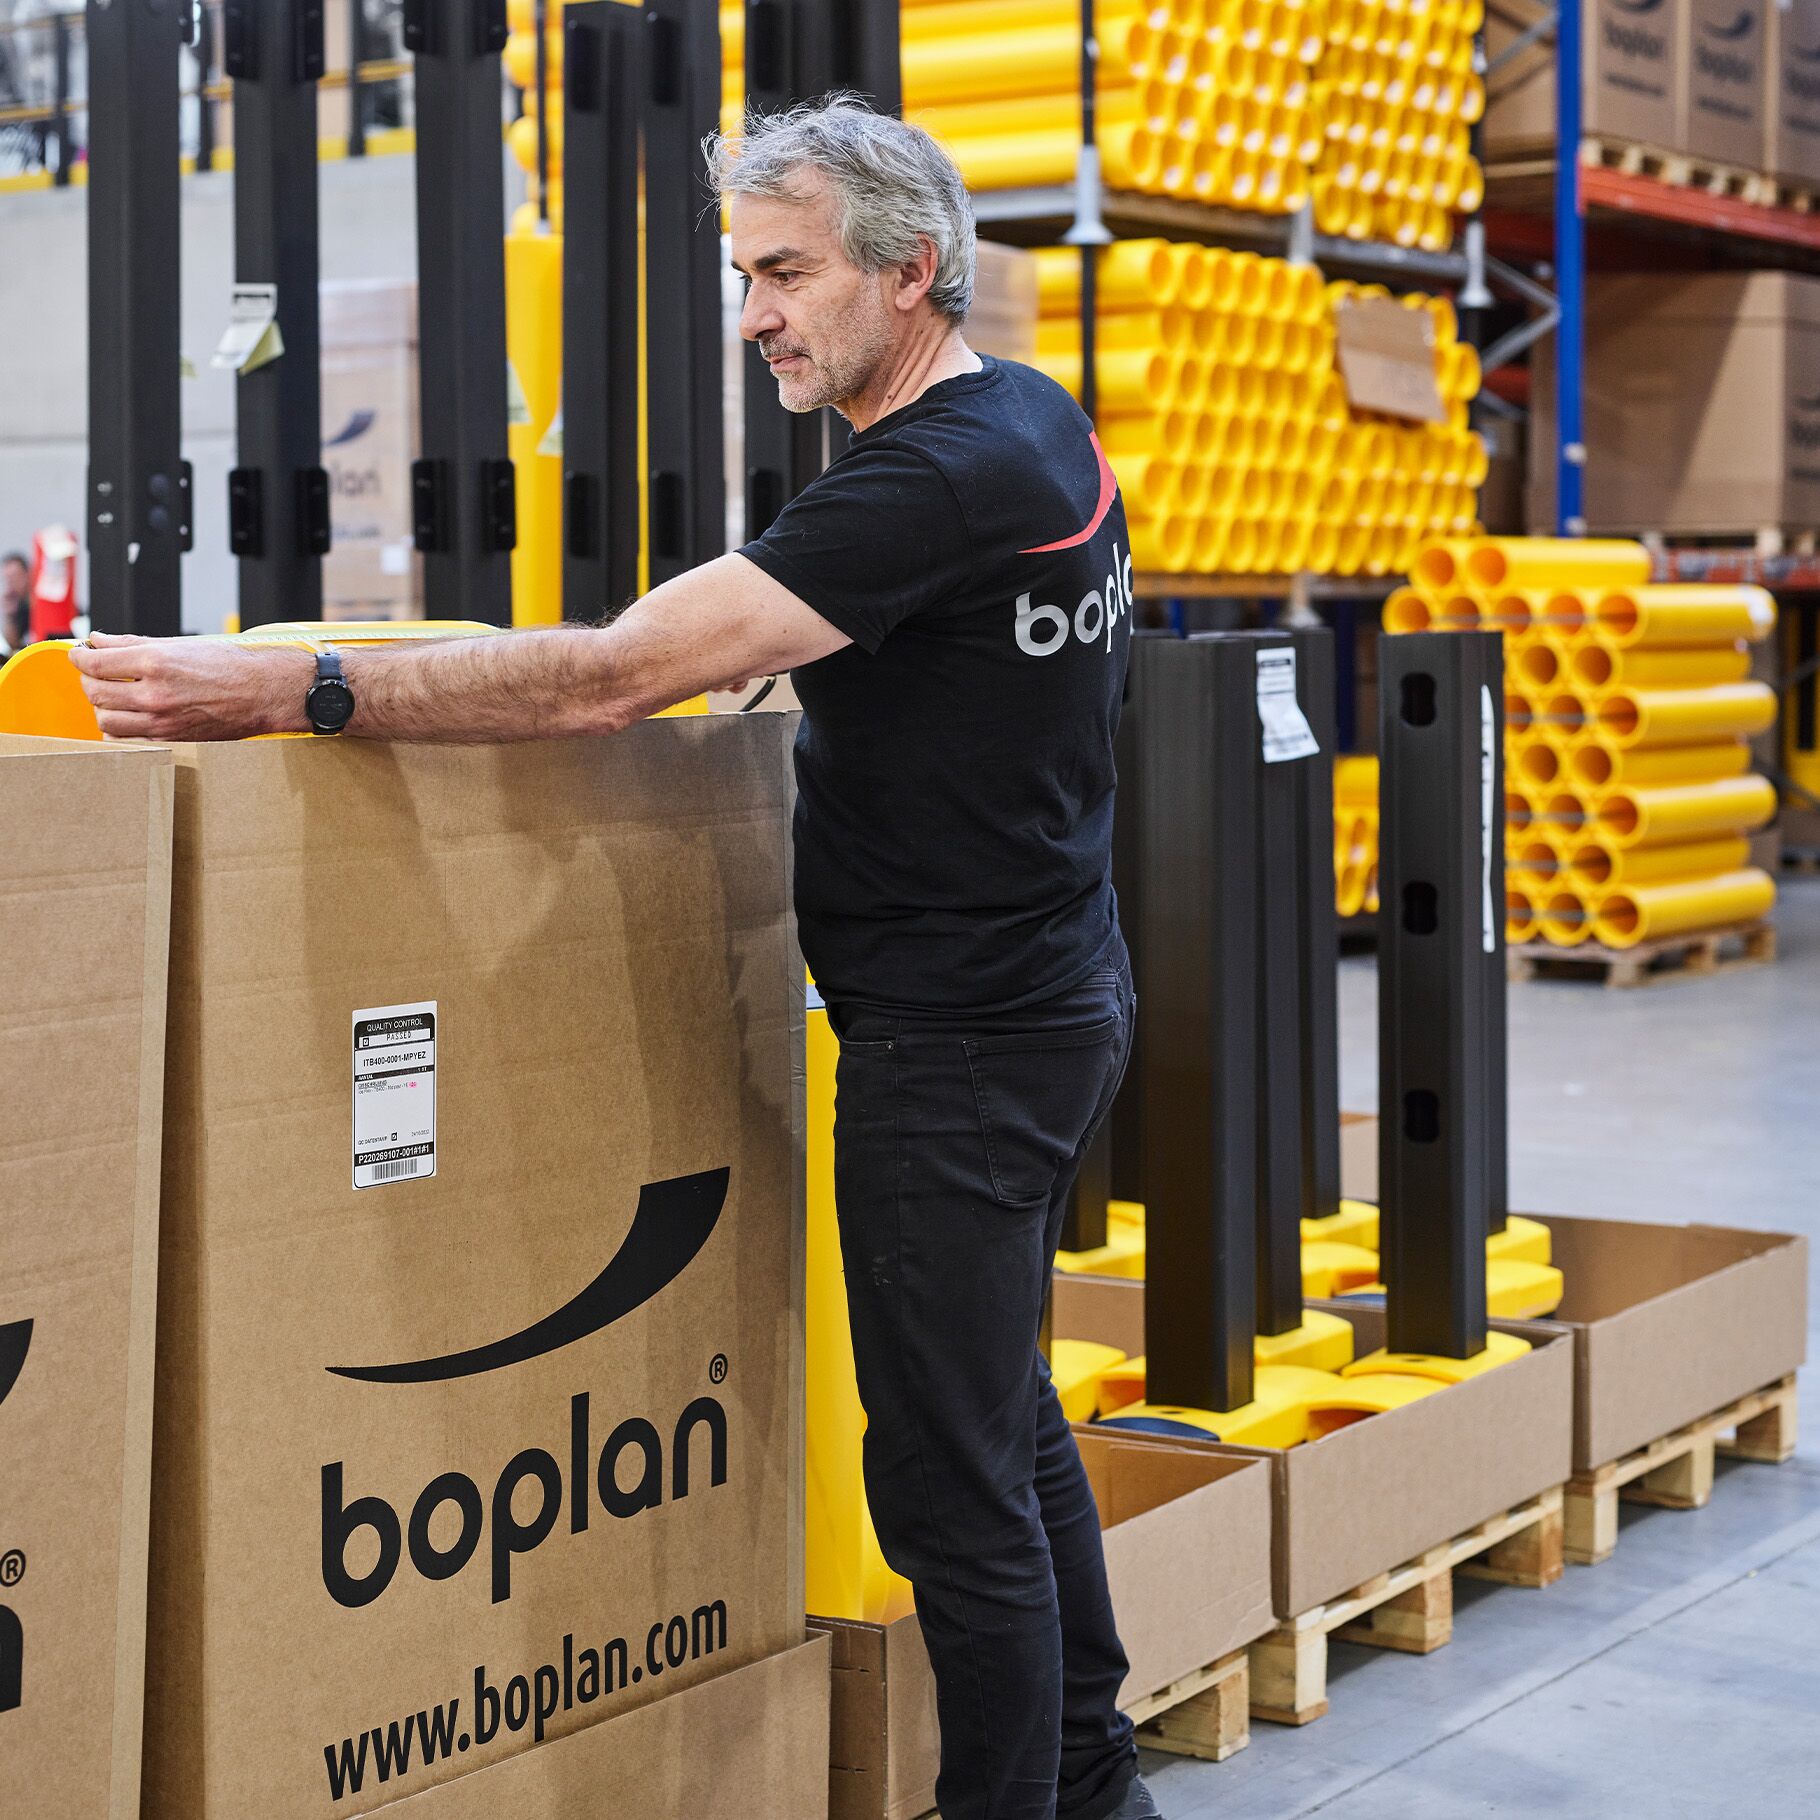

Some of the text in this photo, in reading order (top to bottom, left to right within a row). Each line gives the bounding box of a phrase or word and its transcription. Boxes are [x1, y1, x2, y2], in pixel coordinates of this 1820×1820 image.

[366, 1017, 423, 1032] QUALITY CONTROL
[386, 1031, 412, 1041] PASSED
[363, 1050, 427, 1067] ITB400-0001-MPYEZ
[322, 1392, 727, 1607] boplan
[324, 1599, 727, 1801] www.boplan.com
